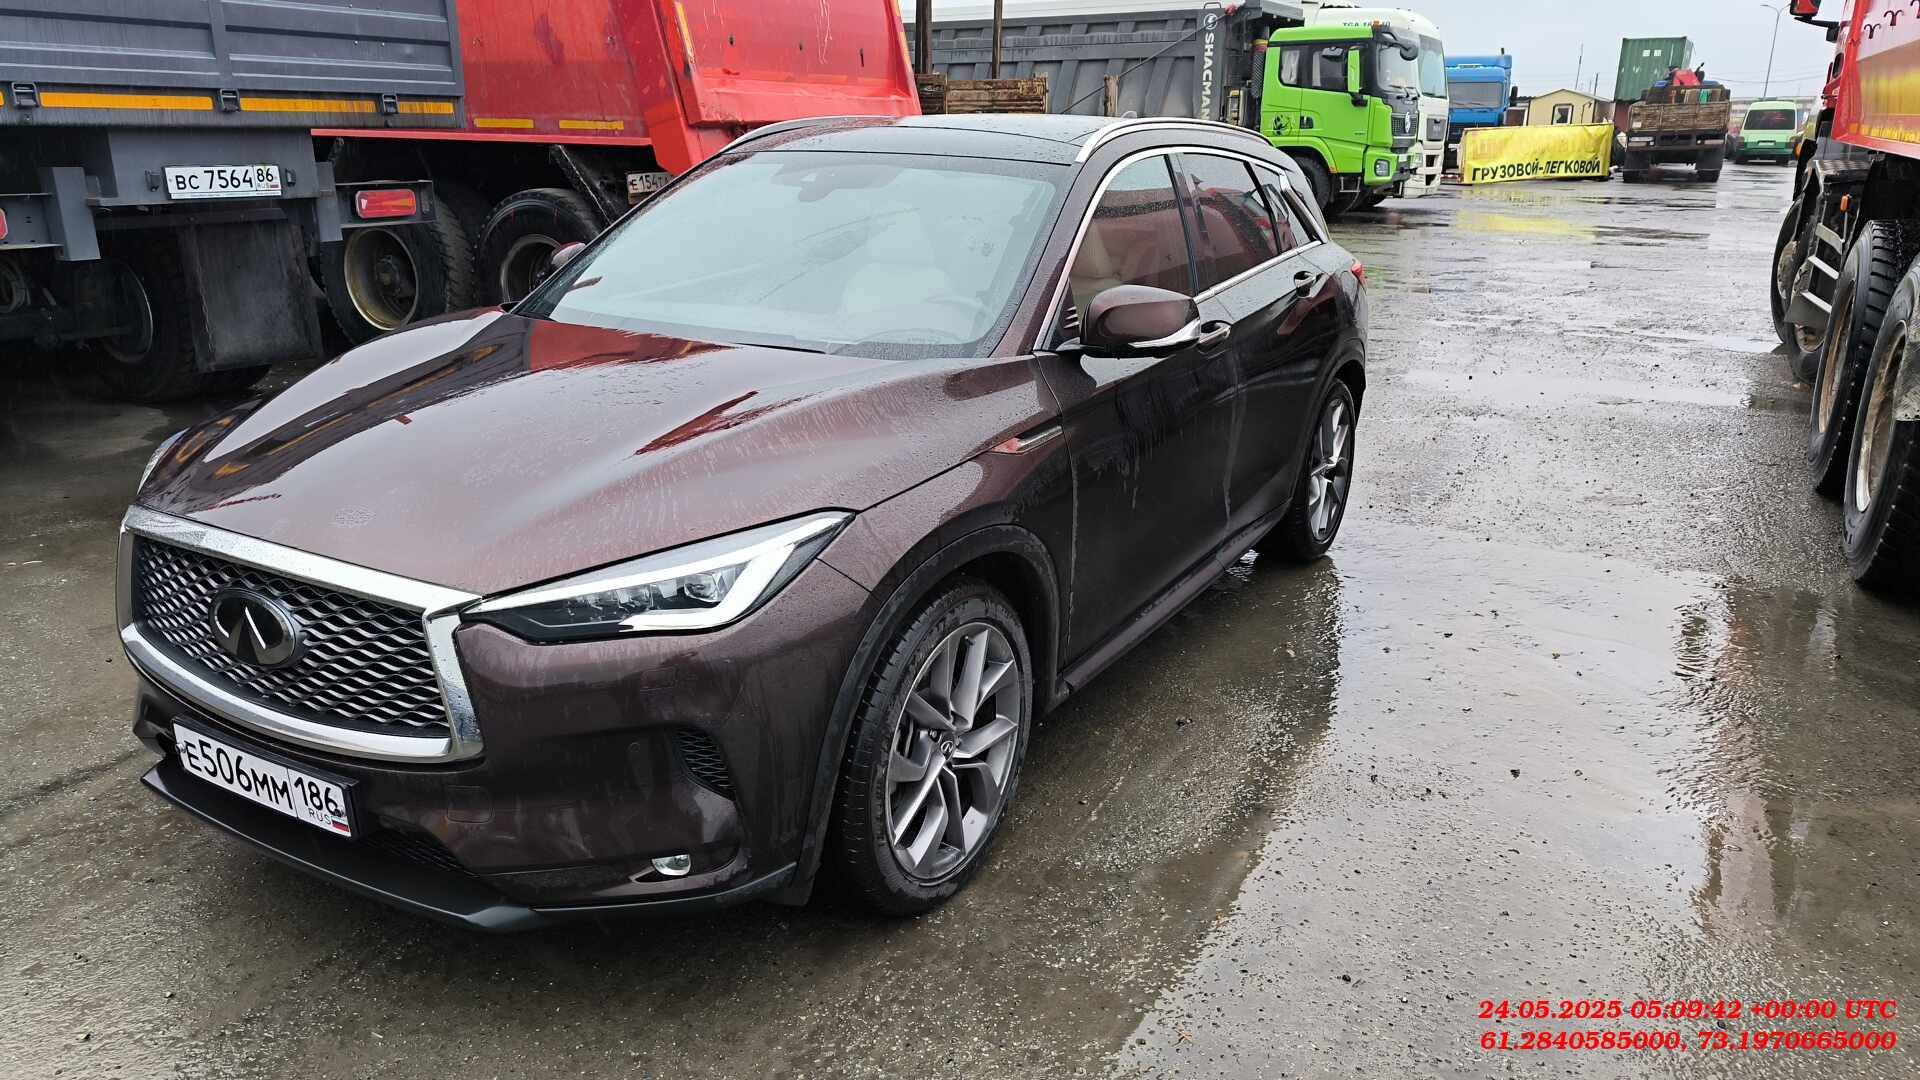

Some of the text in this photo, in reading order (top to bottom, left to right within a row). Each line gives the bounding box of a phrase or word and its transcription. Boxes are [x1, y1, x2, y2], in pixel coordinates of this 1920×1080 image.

[1201, 32, 1215, 120] SHACMAN
[203, 169, 254, 190] 7564
[256, 168, 274, 182] 86
[1471, 157, 1601, 181] ГРУЗОВОЙ-ЛЕГКОВОЙ
[294, 776, 341, 817] 186
[307, 807, 332, 825] RUS
